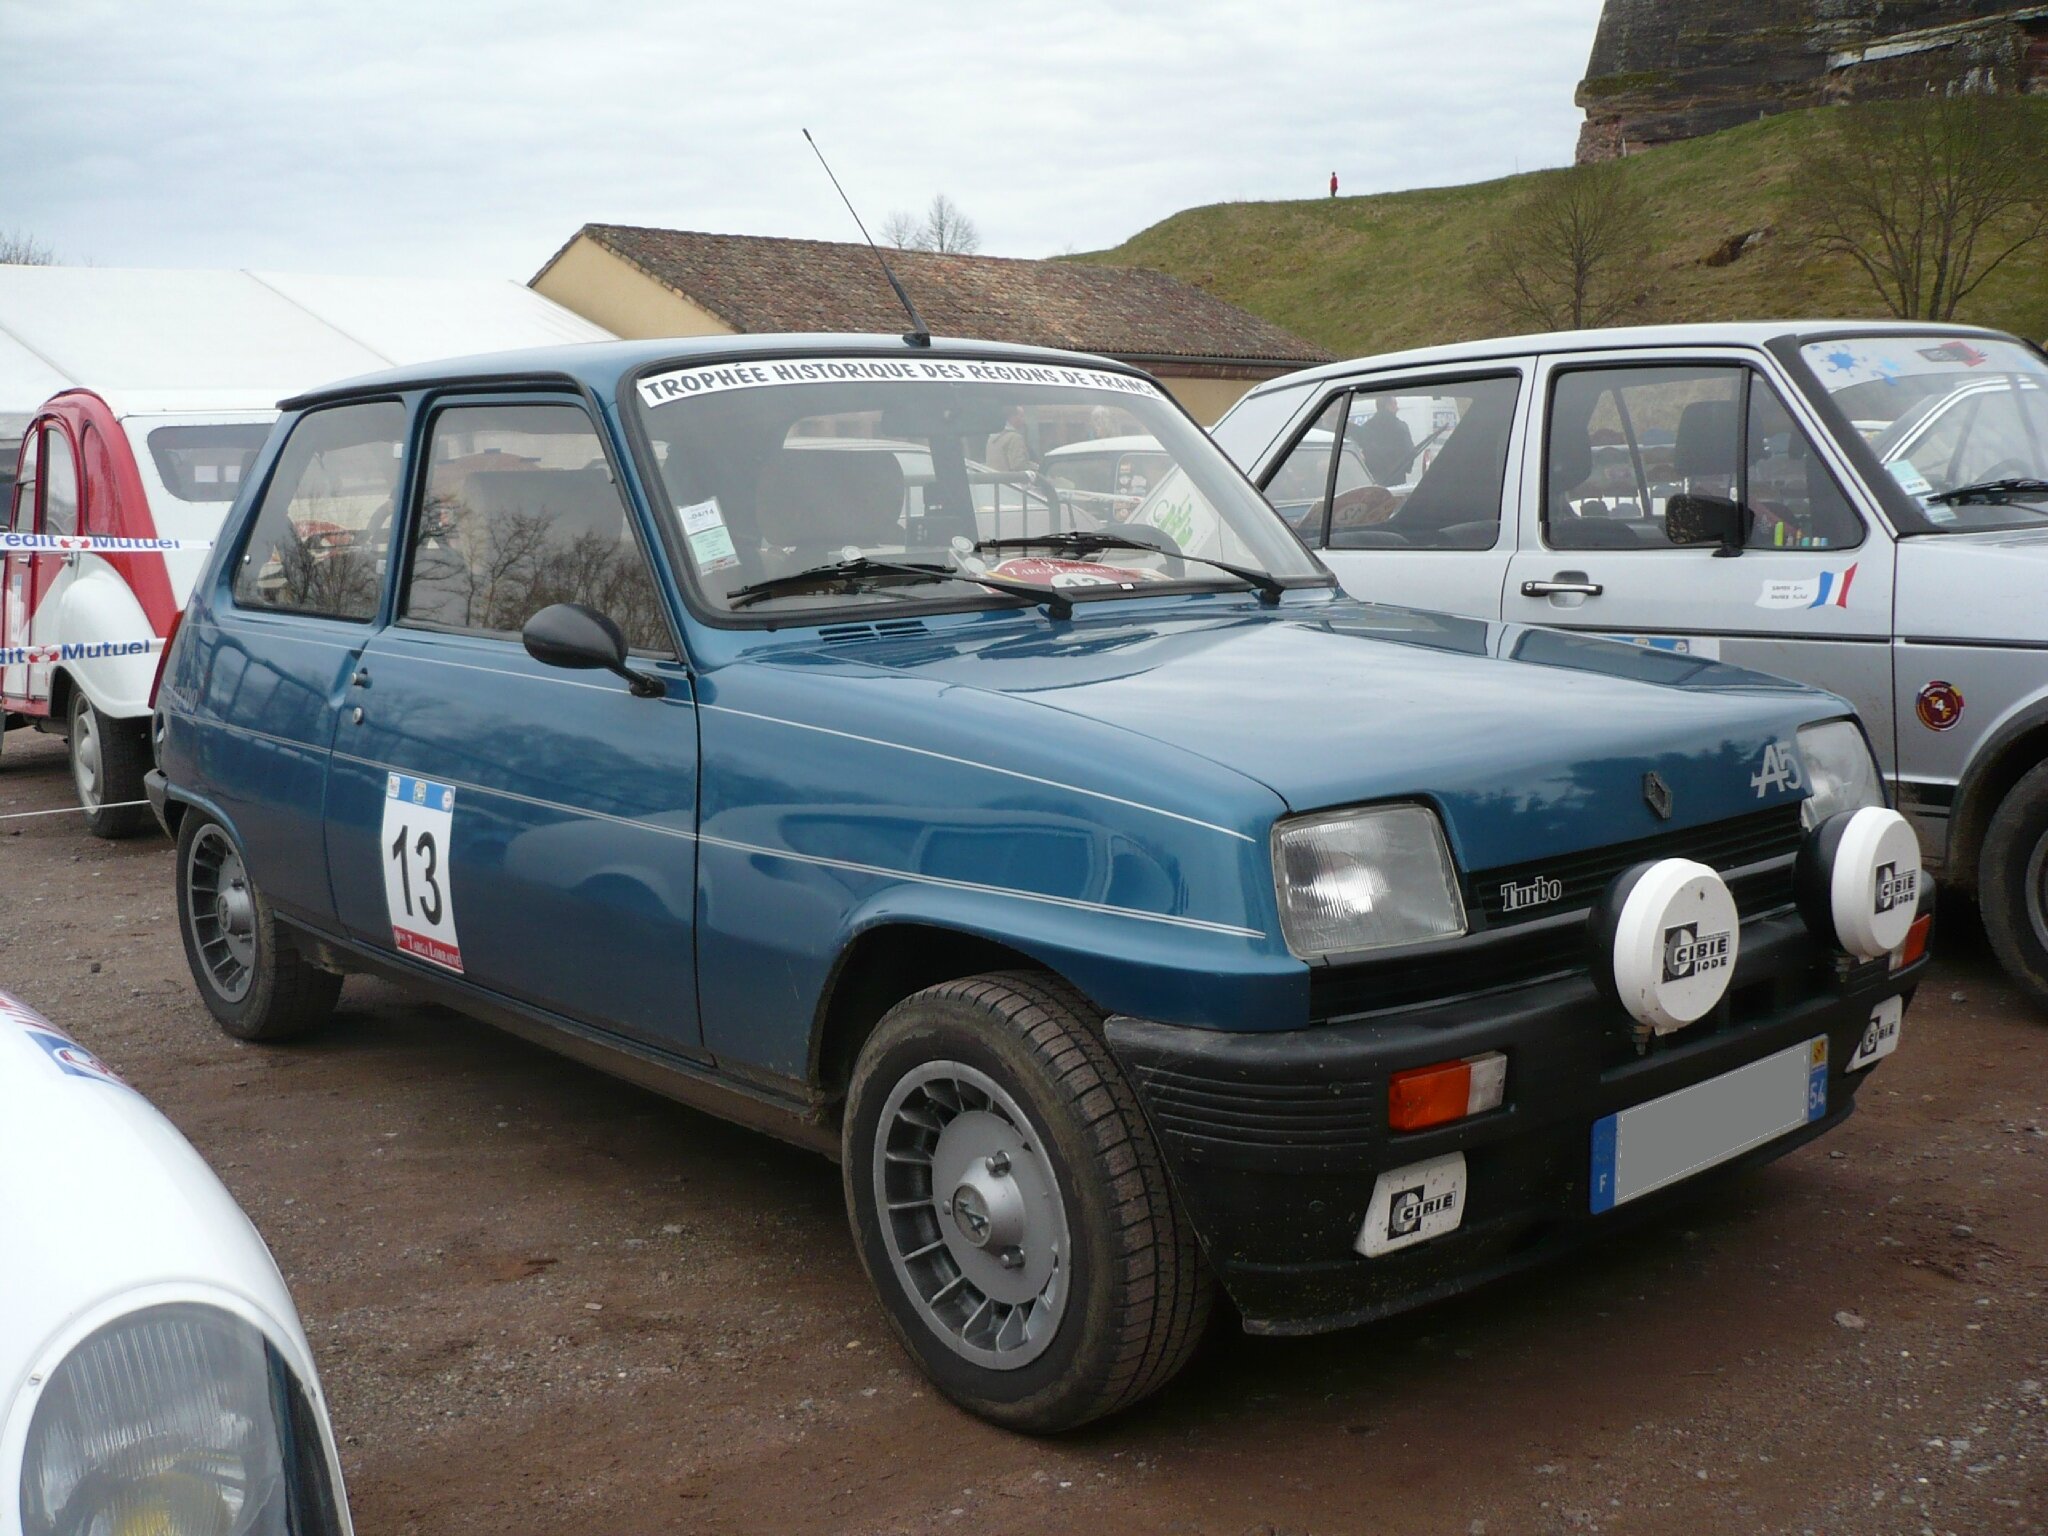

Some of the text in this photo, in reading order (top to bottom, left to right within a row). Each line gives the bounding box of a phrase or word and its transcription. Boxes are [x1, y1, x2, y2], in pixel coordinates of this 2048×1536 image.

[644, 363, 769, 400] TROPHÉE
[772, 363, 918, 381] HISTORIQUE
[919, 363, 966, 379] DES
[967, 361, 1058, 384] RÉGIONS
[1060, 369, 1092, 385] DE
[62, 640, 150, 660] Mutuel
[392, 824, 443, 926] 13
[1500, 876, 1562, 912] Turbo
[1697, 956, 1728, 973] IODE
[1600, 1172, 1608, 1193] F
